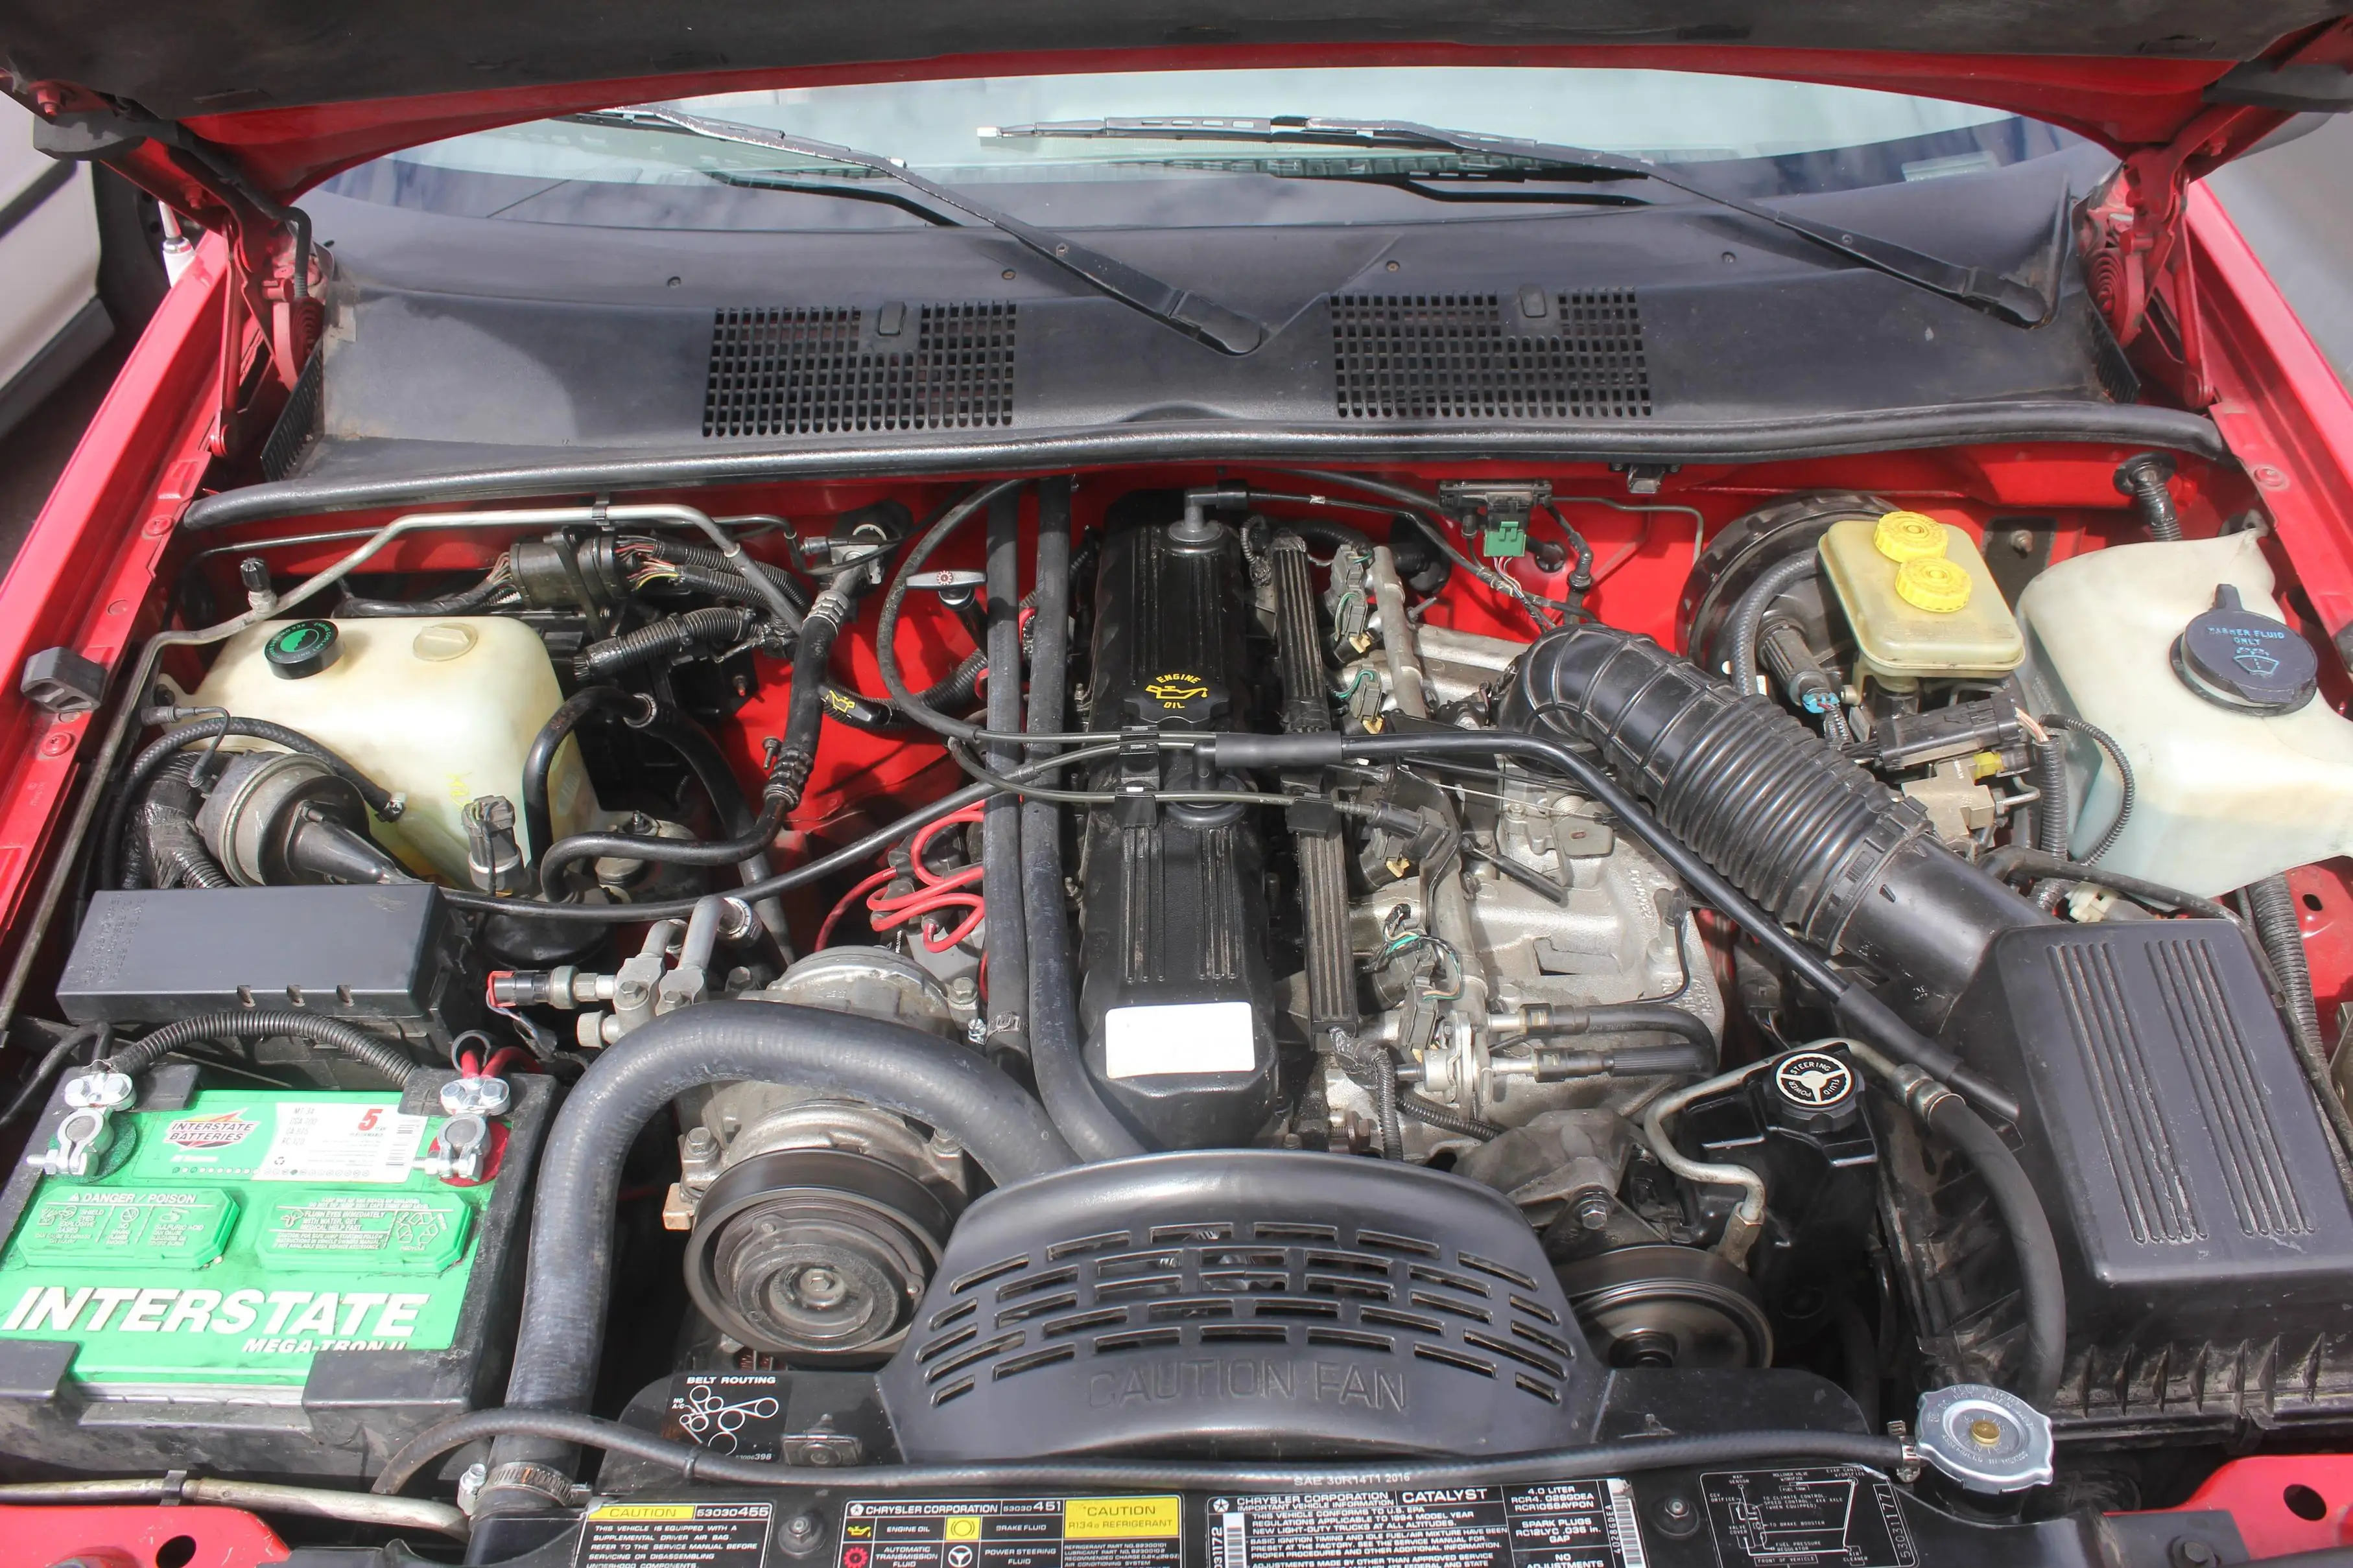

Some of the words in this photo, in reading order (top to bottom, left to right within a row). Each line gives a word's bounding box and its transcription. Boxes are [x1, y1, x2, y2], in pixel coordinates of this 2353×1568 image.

[2254, 630, 2285, 639] FLUID
[2233, 637, 2261, 646] ONLY
[1155, 673, 1201, 684] ENGINE
[1790, 1061, 1831, 1075] STEERING
[1788, 1081, 1812, 1097] POWER
[1823, 1079, 1840, 1095] FLUID
[358, 1108, 383, 1131] 5
[171, 1122, 254, 1131] INTERSTATE
[169, 1132, 244, 1141] BATTERIES
[82, 1193, 136, 1203] DANGER
[147, 1193, 197, 1204] POISON
[3, 1286, 431, 1337] INTERSTATE
[241, 1338, 385, 1353] MEGA-TRON
[686, 1376, 717, 1385] BELT
[720, 1376, 776, 1385] ROUTING
[1088, 1358, 1297, 1408] CAUTION
[1314, 1361, 1408, 1412] FAN
[1294, 1477, 1323, 1486] SAE
[1327, 1473, 1381, 1486] 30R14T1
[1385, 1472, 1412, 1483] 2016
[1402, 1488, 1487, 1503] CATALYST
[1548, 1486, 1576, 1494] LITER
[1236, 1495, 1301, 1506] CHRYSLER
[1304, 1492, 1388, 1503] CORPORATION
[609, 1508, 676, 1517] CAUTION
[696, 1506, 768, 1517] 53030455
[866, 1504, 922, 1515] CHRYSLER
[923, 1503, 998, 1514] CORPORATION
[1087, 1505, 1156, 1517] CAUTION
[1237, 1504, 1290, 1512] IMPORTANT
[1332, 1499, 1394, 1508] INFORMATION
[1316, 1508, 1369, 1517] CONFORMS
[1102, 1519, 1173, 1528] REFRIGERANT
[1252, 1519, 1315, 1528] REGULATIONS
[1318, 1516, 1373, 1525] APPLICABLE
[1415, 1512, 1448, 1521] MODEL
[1522, 1519, 1555, 1528] SPARK
[1558, 1517, 1592, 1527] PLUGS
[1878, 1493, 1911, 1558] 53031177
[995, 1524, 1022, 1532] BRAKE
[1277, 1525, 1330, 1534] LIGHT-DUTY
[1333, 1523, 1370, 1532] TRUCKS
[1406, 1520, 1457, 1528] ALTITUDES.
[1562, 1526, 1587, 1534] .035
[1605, 1504, 1622, 1554] 4028GDEA
[1277, 1536, 1313, 1544] IGNITION
[1386, 1530, 1423, 1539] FUEL/AIR
[1425, 1529, 1461, 1538] MIXTURE
[1548, 1535, 1570, 1543] GAP
[1251, 1545, 1283, 1553] PRESET
[1394, 1538, 1429, 1547] SERVICE
[1430, 1537, 1467, 1545] MANUAL
[1286, 1550, 1342, 1559] PROCEDURES
[1364, 1547, 1392, 1556] OTHER
[1393, 1545, 1443, 1554] ADDITIONAL
[1443, 1542, 1503, 1551] INFORMATION.
[1016, 1547, 1056, 1556] STEERING
